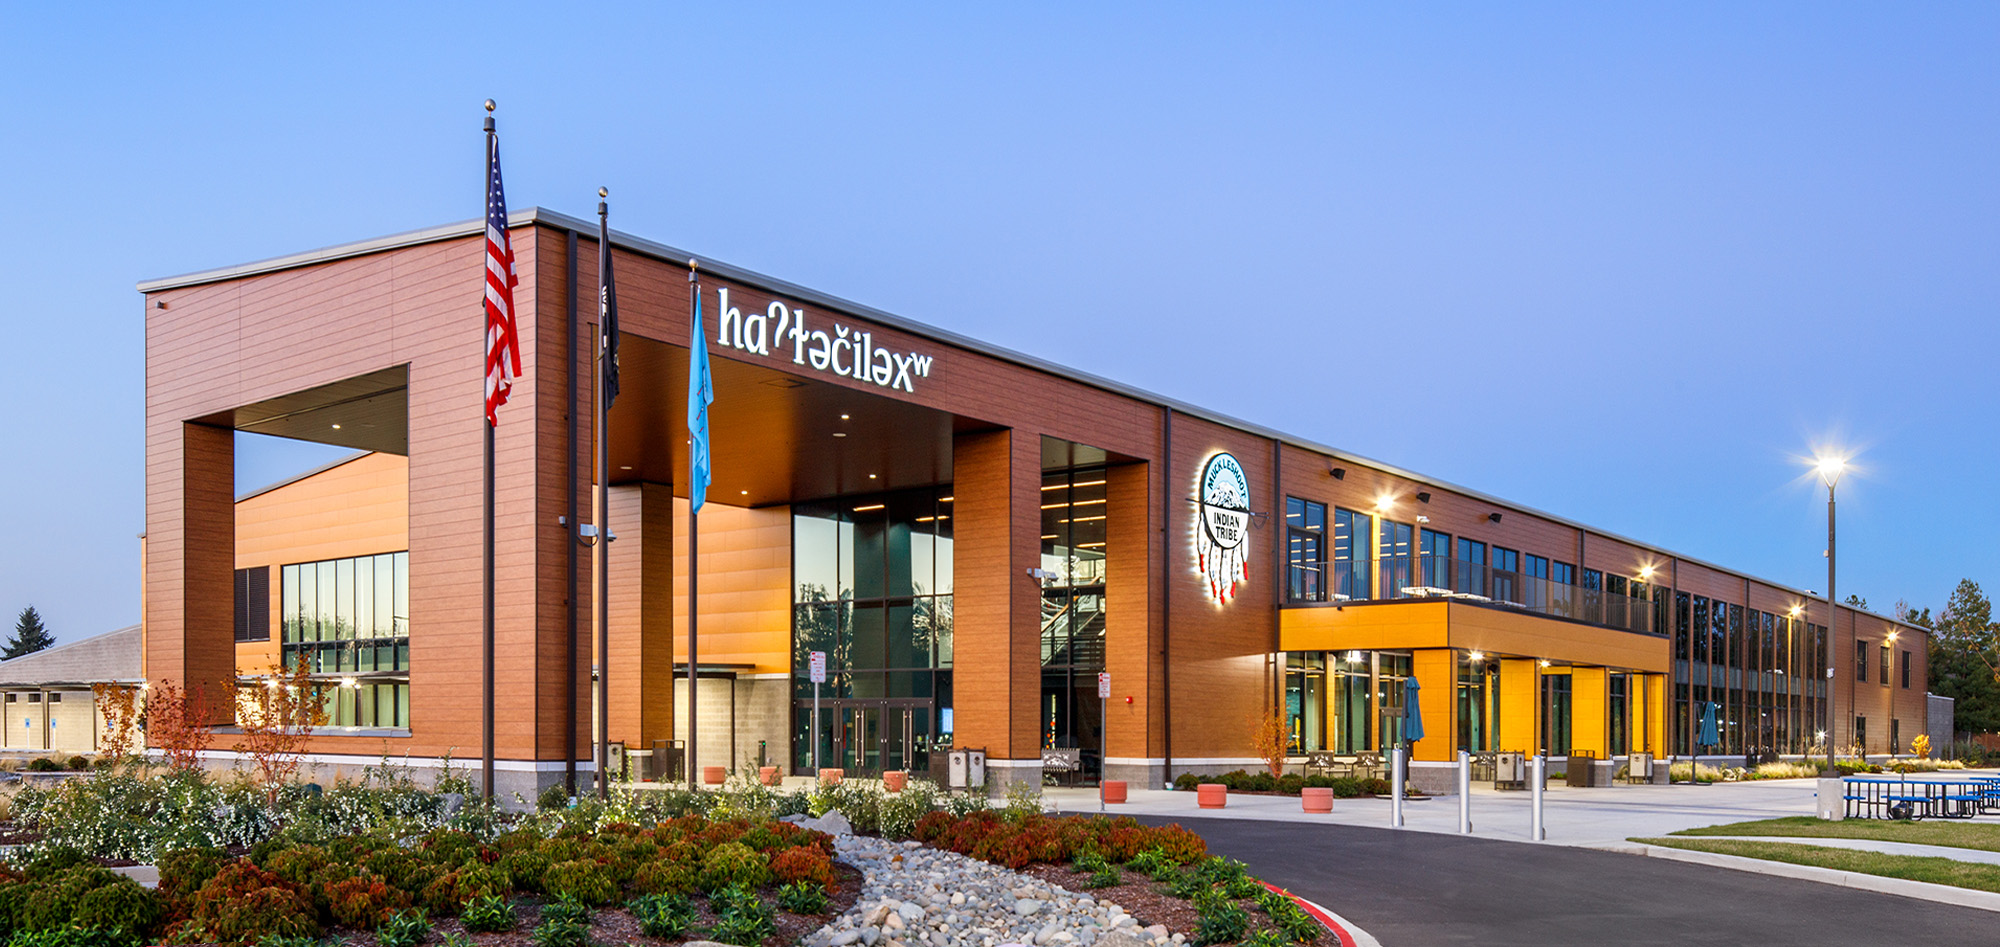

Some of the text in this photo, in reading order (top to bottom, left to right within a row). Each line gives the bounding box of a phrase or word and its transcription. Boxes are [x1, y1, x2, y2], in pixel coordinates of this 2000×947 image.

[1207, 458, 1247, 499] MUCKLESHOOT
[1214, 512, 1240, 529] INDIAN
[1215, 526, 1238, 542] TRIBE
